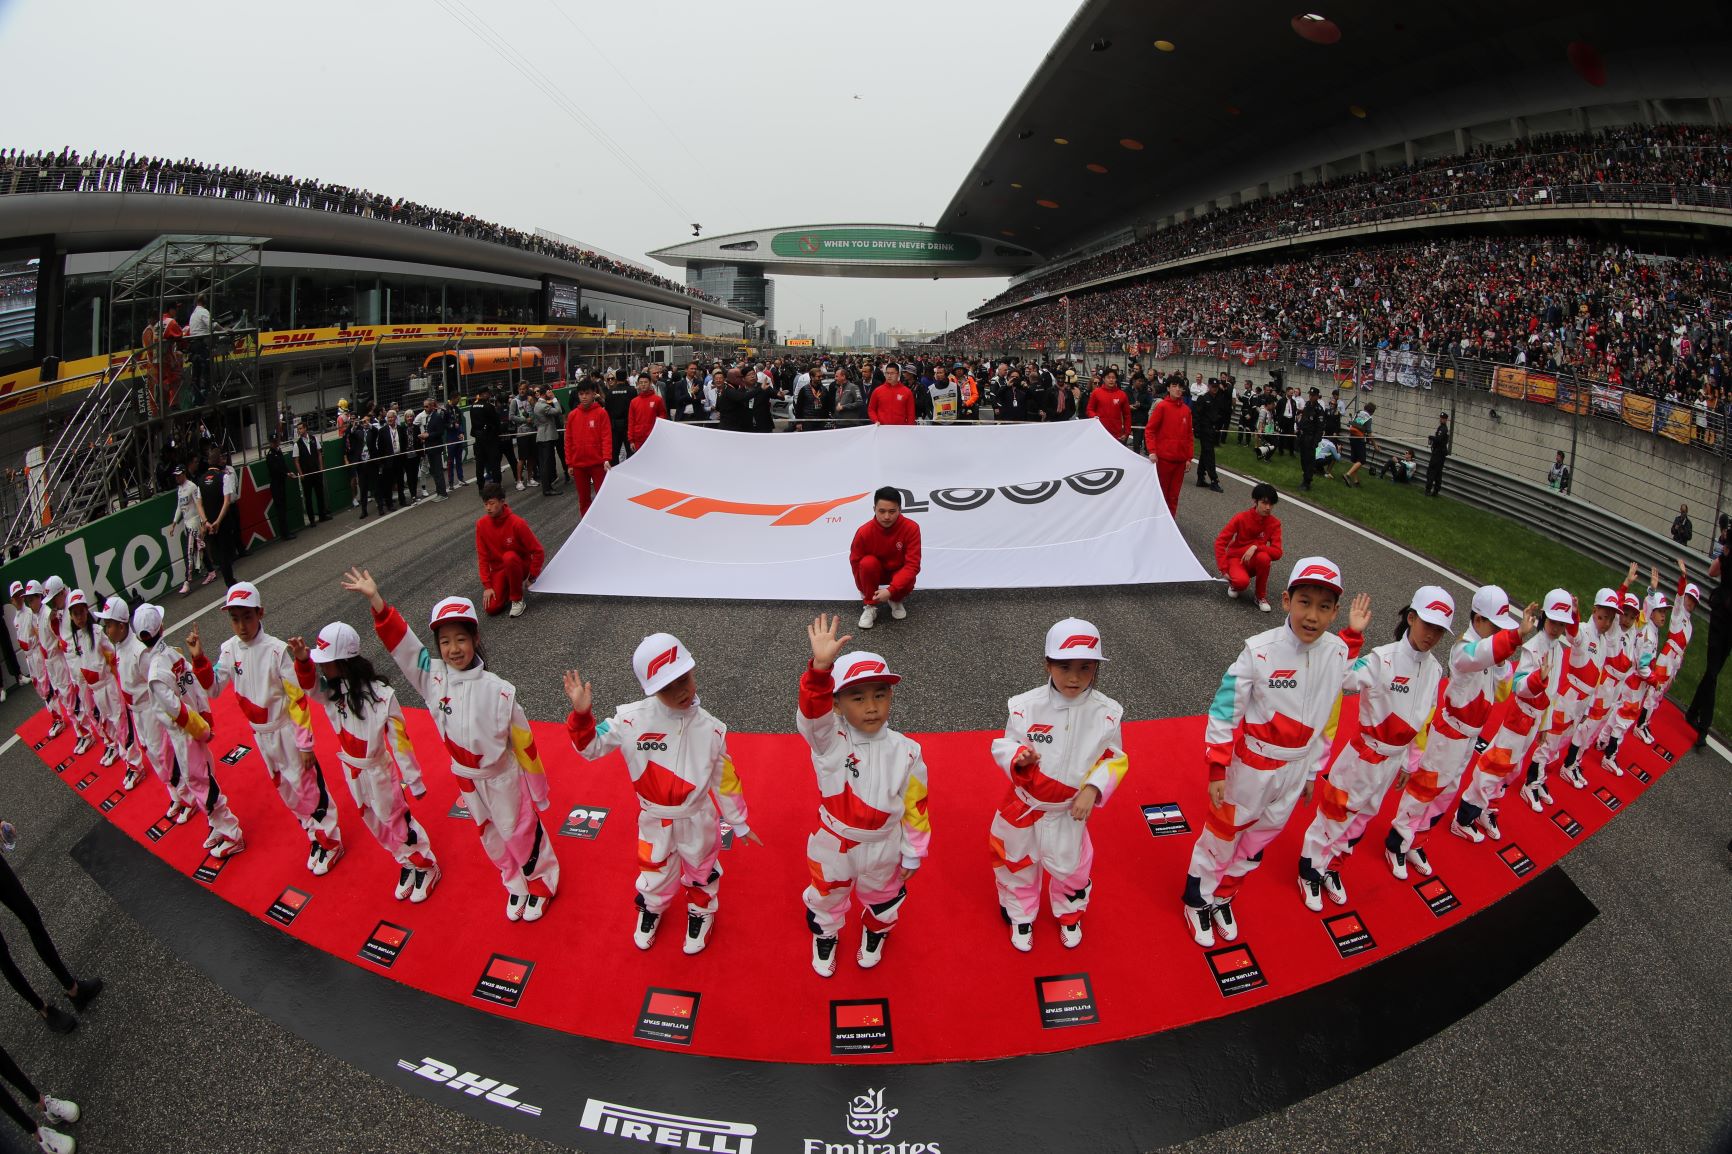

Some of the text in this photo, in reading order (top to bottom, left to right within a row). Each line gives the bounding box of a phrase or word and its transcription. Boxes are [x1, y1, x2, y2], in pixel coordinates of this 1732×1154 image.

[823, 240, 955, 251] WHEN YOU DRIVE NEVER DRINK
[137, 387, 146, 414] EXTRA
[825, 515, 843, 524] TM
[1268, 679, 1298, 689] 1000
[636, 742, 668, 751] 1000
[1221, 970, 1259, 984] FUTURE STAR
[481, 980, 495, 988] STAR
[495, 984, 518, 994] FUTURE
[1063, 1004, 1091, 1012] FUTURE
[643, 1018, 689, 1030] FUTURE STAR
[405, 1056, 530, 1112] DHL
[579, 1098, 758, 1154] PIRELLI
[803, 1138, 941, 1154] Emirates
